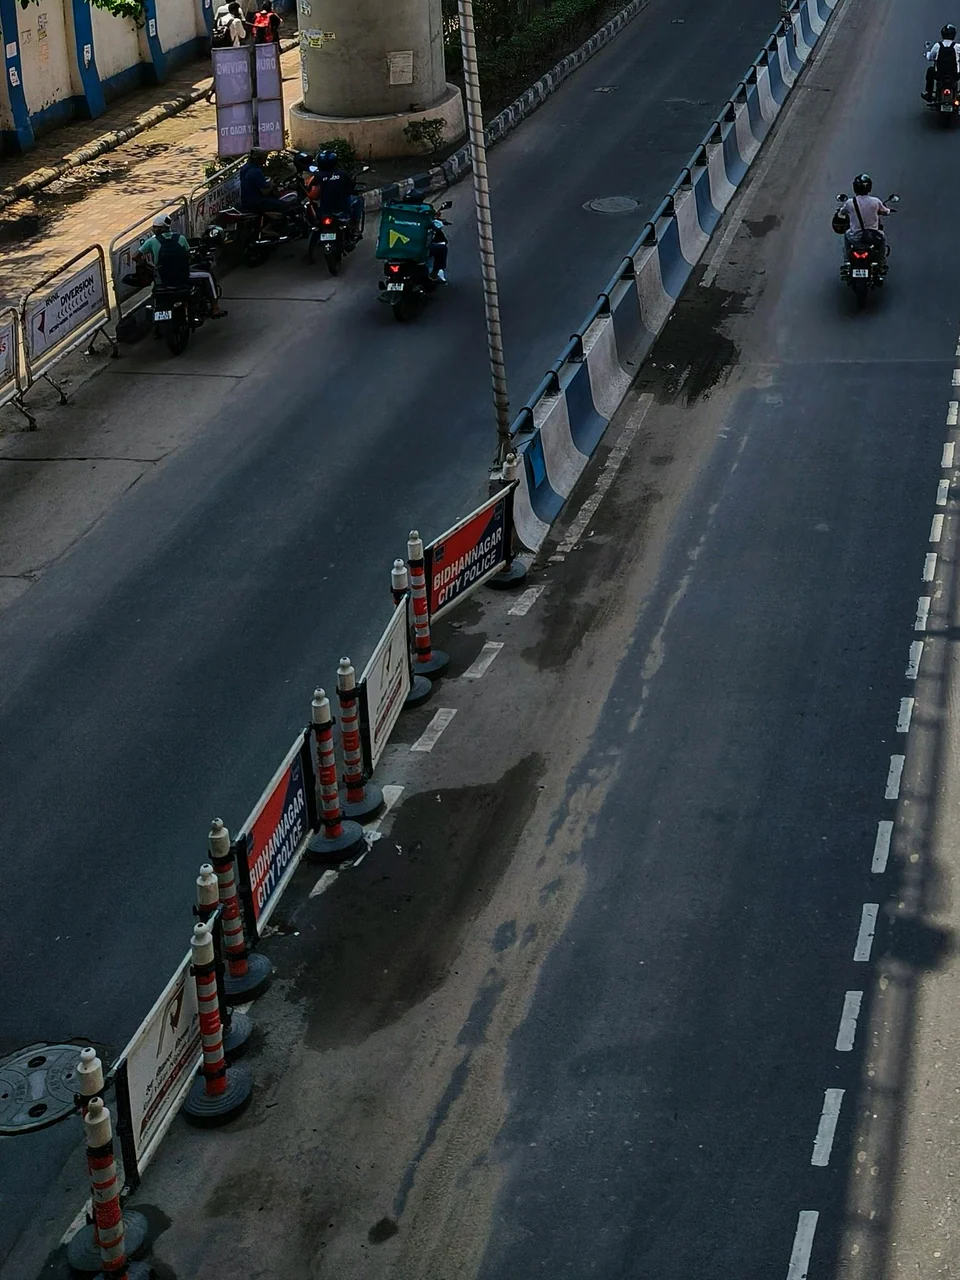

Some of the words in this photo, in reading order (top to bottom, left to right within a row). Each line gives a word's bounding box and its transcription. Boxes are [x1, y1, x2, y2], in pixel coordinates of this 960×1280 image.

[60, 274, 94, 306] DIVERSION
[433, 527, 502, 591] BIDHANNAGAR
[438, 576, 462, 605] CITY
[463, 549, 497, 586] POLICE
[249, 788, 305, 892] BIDHANNAGAR
[257, 871, 276, 909] CITY
[276, 818, 303, 877] POLICE
